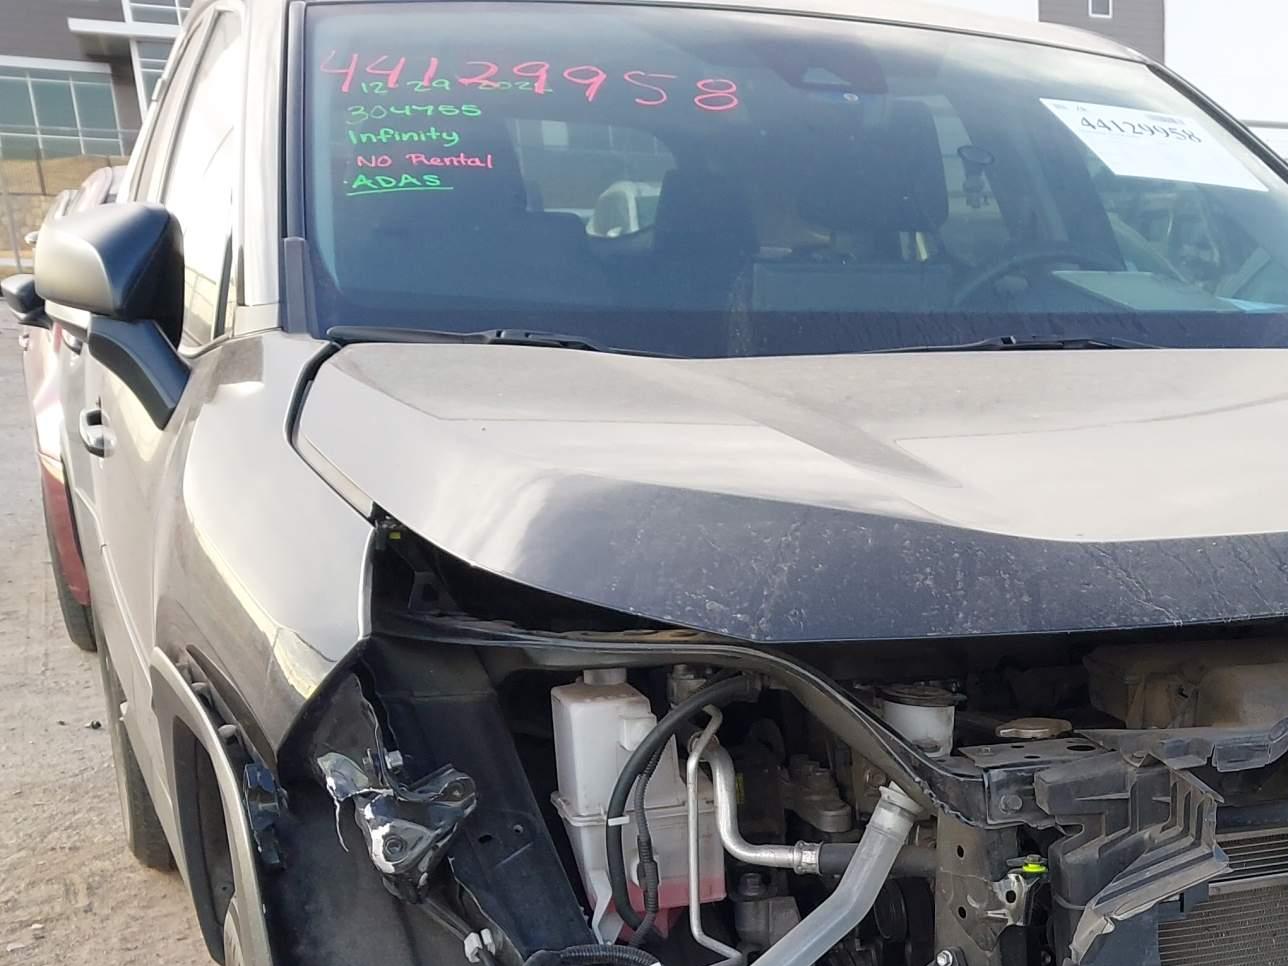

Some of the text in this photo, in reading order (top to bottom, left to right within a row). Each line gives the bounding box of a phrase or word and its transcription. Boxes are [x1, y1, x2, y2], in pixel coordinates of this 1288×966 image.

[318, 49, 740, 111] 44129958
[360, 82, 389, 94] 12
[406, 78, 452, 93] 29
[348, 127, 460, 147] Infinity
[1080, 116, 1203, 143] 44129958
[405, 152, 494, 168] Rental
[351, 173, 442, 189] ADAS
